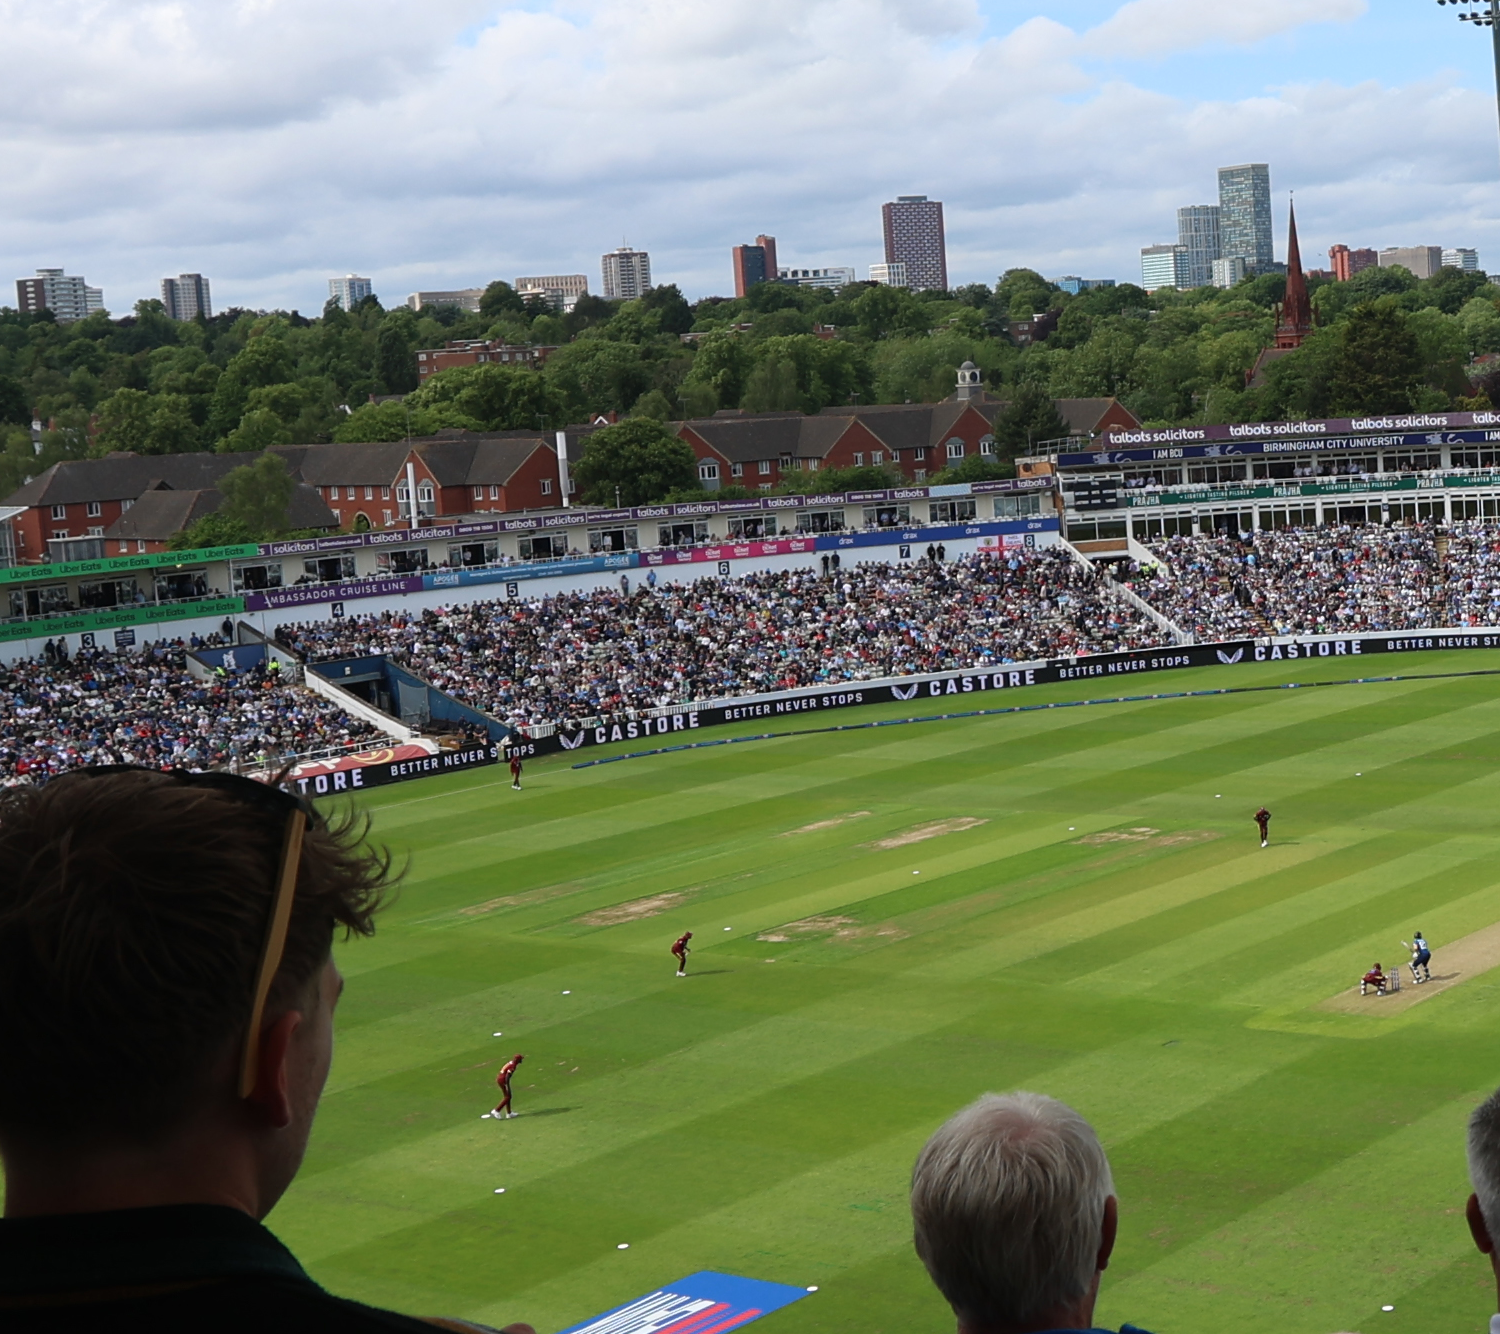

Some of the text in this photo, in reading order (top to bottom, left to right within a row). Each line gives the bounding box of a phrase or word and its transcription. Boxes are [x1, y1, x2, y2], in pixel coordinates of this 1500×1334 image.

[1229, 421, 1326, 436] talbots solicitors
[1351, 415, 1447, 430] talbots solicitors
[1109, 428, 1205, 443] talbots solicitors
[1263, 436, 1404, 453] BIRMINGHAM CITY UNIVERSITY
[1157, 448, 1183, 459] AM BCU
[369, 531, 403, 544] talbots
[410, 527, 451, 540] solicitors
[1026, 535, 1033, 546] 8
[901, 546, 909, 557] 7
[720, 563, 728, 573] 6
[264, 581, 406, 608] AMBASSADOR CRUISE LINE
[508, 584, 516, 595] 5
[333, 605, 342, 616] 4
[84, 635, 92, 647] 3
[1387, 639, 1433, 650] BETTER
[1439, 637, 1478, 648] NEVER
[1254, 640, 1363, 661] CASTORE
[929, 669, 1035, 697] CASTORE
[594, 711, 700, 744] CASTORE
